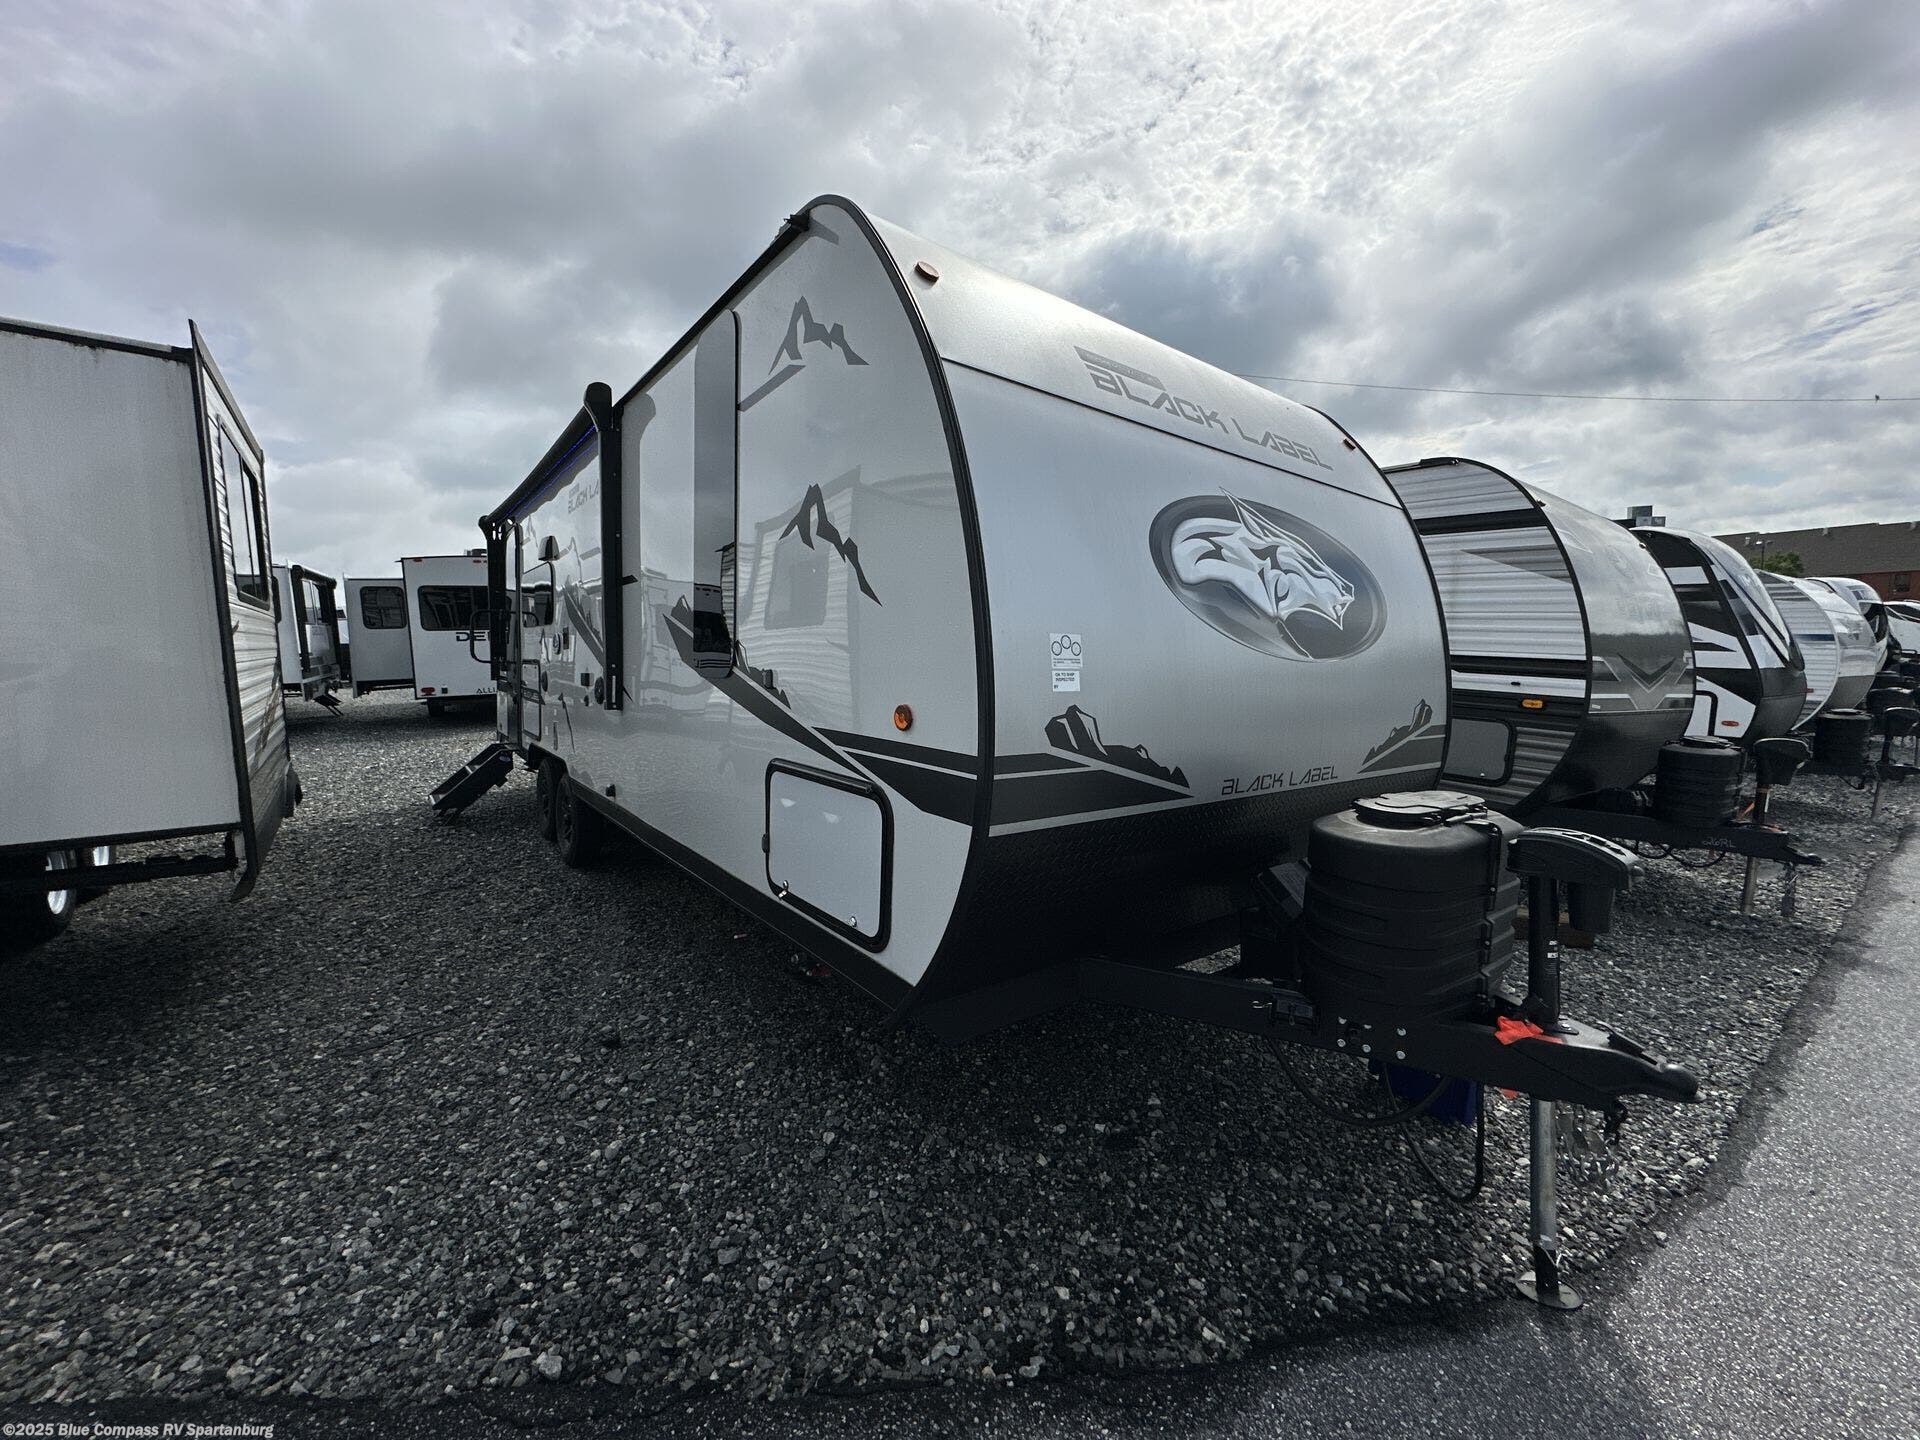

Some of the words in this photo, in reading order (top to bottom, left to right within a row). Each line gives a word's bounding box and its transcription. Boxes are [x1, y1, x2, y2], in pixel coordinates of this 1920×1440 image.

[1084, 362, 1229, 434] BLACK
[1232, 417, 1333, 471] LABEL
[1221, 773, 1284, 796] BLACK
[1289, 766, 1338, 786] LABEL
